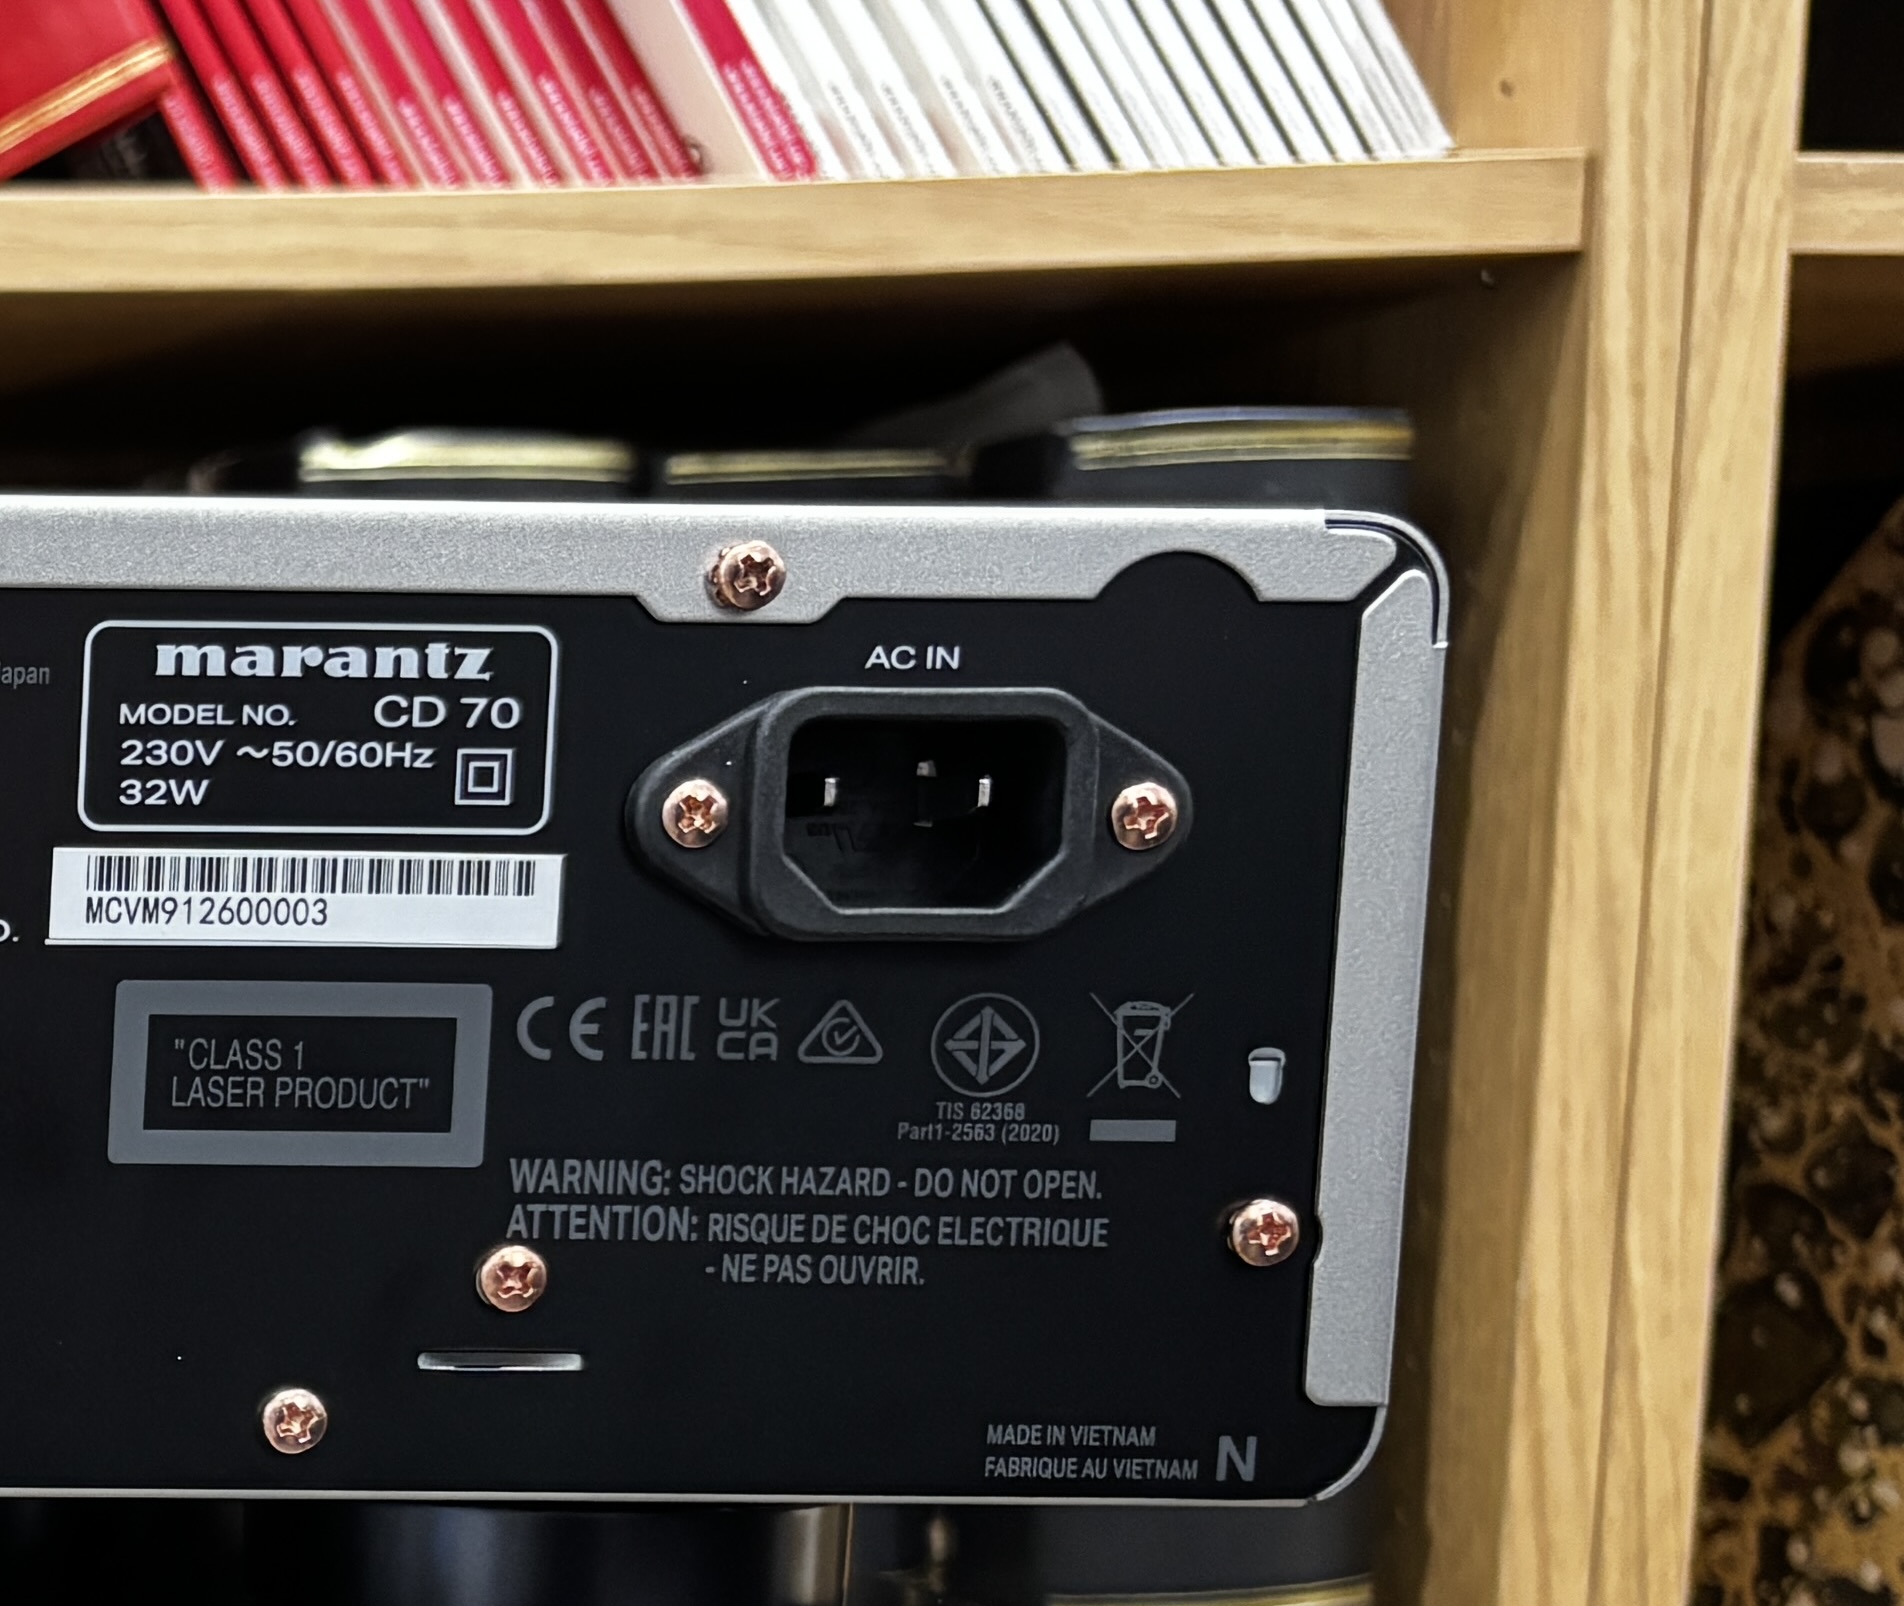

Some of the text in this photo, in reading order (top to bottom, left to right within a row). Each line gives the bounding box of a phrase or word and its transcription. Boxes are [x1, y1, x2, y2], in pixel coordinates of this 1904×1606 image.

[156, 643, 492, 680] marantz
[865, 646, 959, 669] AC IN
[120, 695, 520, 728] MODEL NO. CD 70
[121, 740, 224, 765] 230V
[120, 779, 209, 805] 32W
[86, 897, 327, 925] MCVM912600003
[175, 1038, 303, 1070] "CLASS 1
[172, 1076, 429, 1109] LASER PRODUCT"
[510, 1158, 670, 1196] WARNING:
[680, 1164, 773, 1194] SHOCK
[781, 1167, 890, 1196] HAZARD
[915, 1168, 953, 1197] DO
[961, 1169, 1017, 1198] NOT
[1024, 1169, 1101, 1199] OPEN.
[506, 1204, 1109, 1247] ATTENTION: RISQUE DE CHOC ELECTRIQUE
[722, 1254, 757, 1282] NE
[763, 1254, 812, 1284] PAS
[819, 1255, 924, 1284] OUVRIR.
[987, 1424, 1156, 1446] MADE IN VIETNAM
[985, 1457, 1198, 1479] FABRIQUE AU VIETNAM
